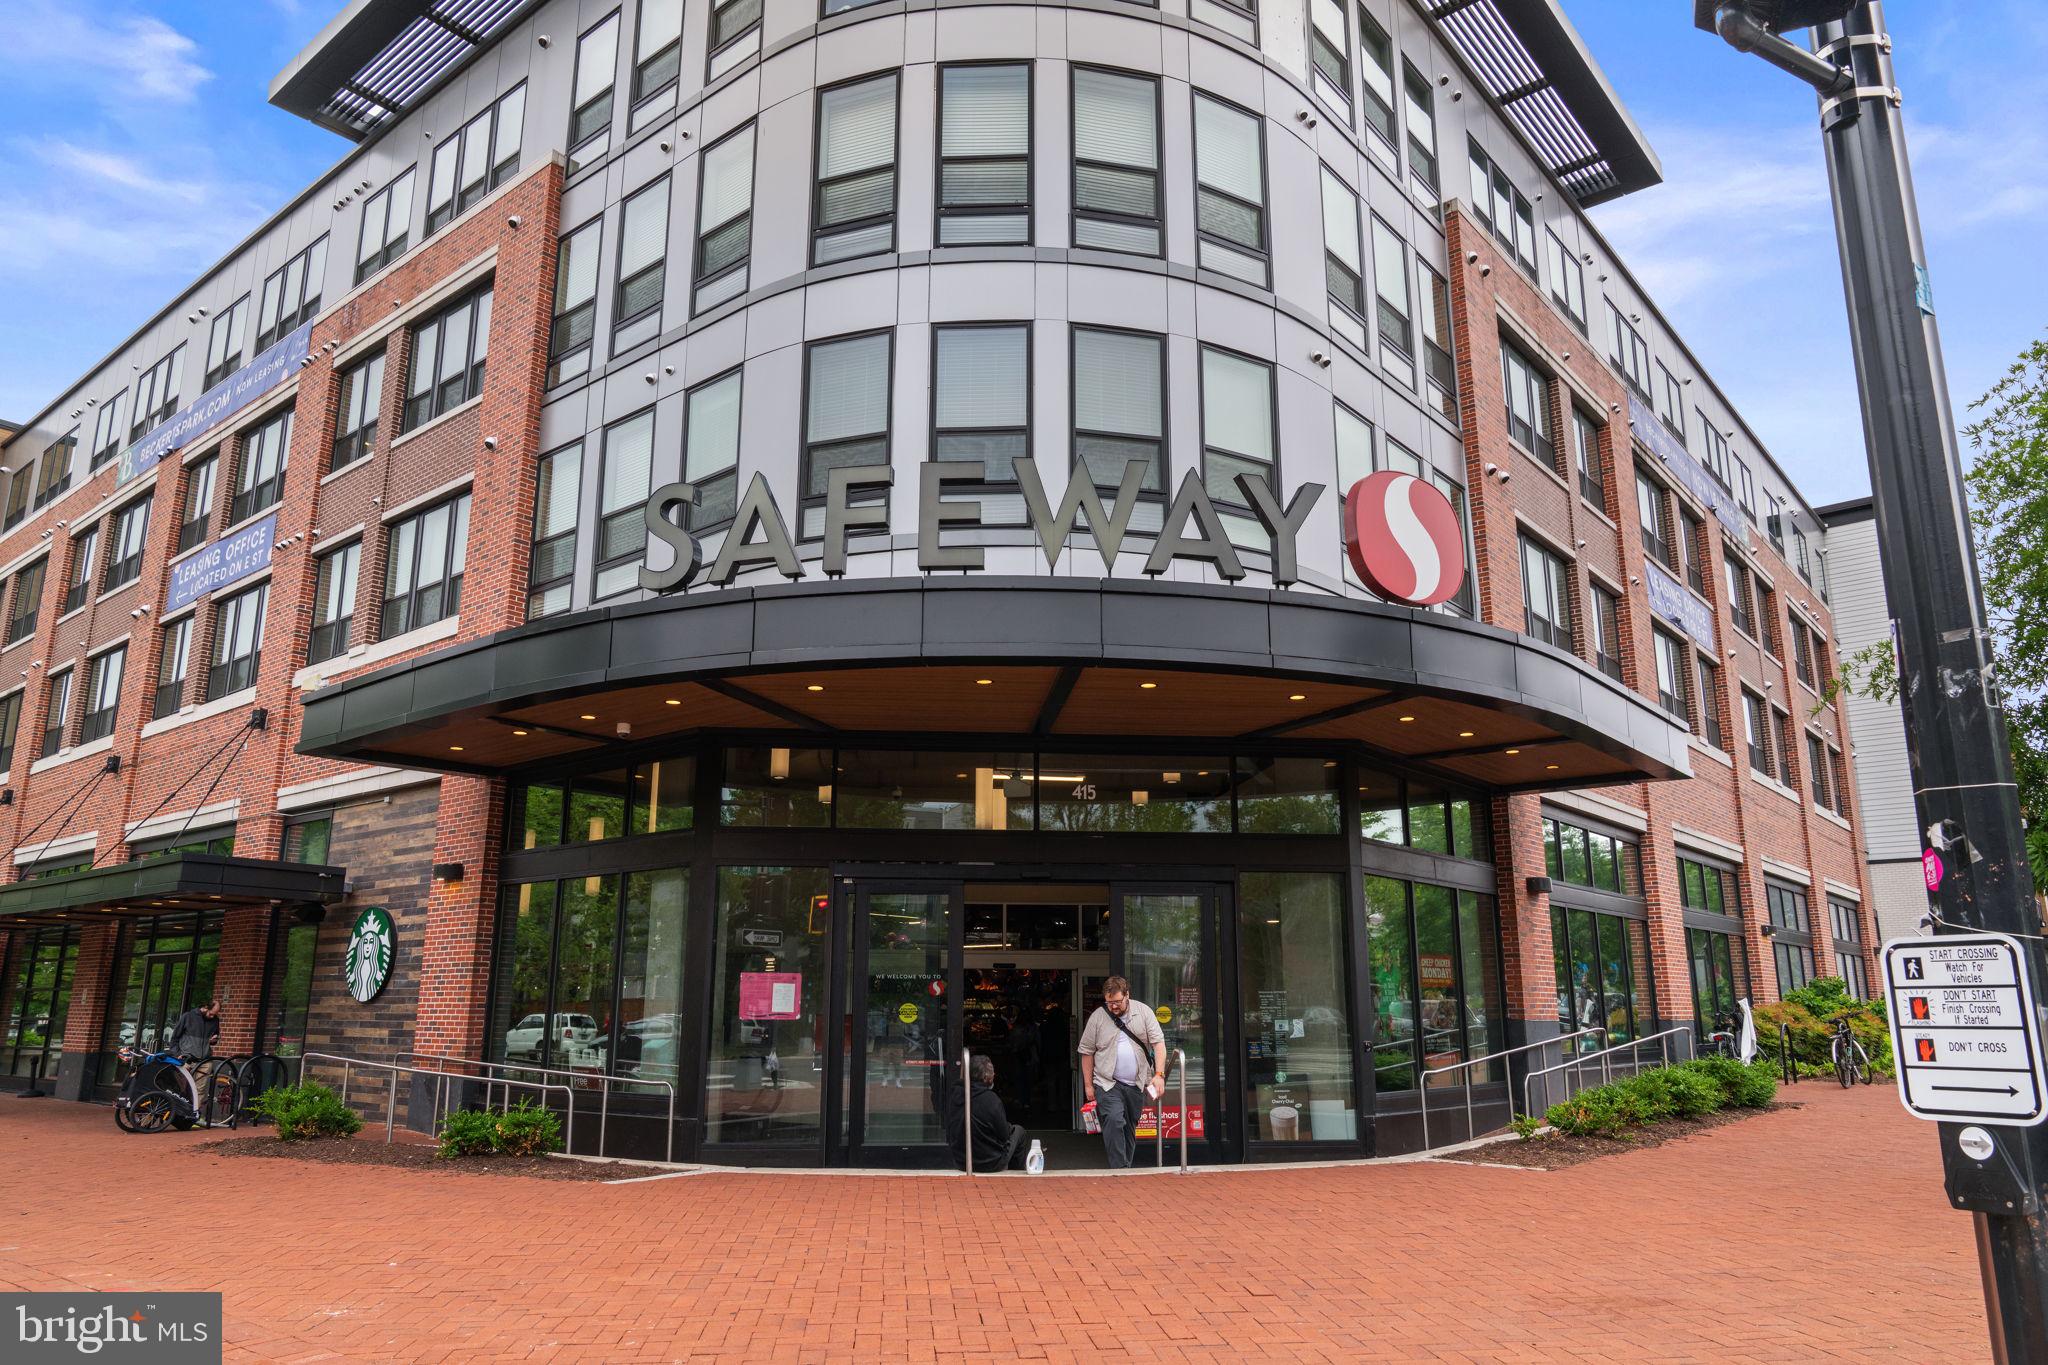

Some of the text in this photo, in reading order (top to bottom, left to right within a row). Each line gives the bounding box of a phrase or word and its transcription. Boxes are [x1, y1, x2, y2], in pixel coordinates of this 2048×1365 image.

[235, 379, 253, 396] NOW
[254, 355, 285, 384] LEASING
[638, 454, 1326, 593] SAFEWAY
[178, 526, 266, 585] LEASING OFFICE
[190, 549, 264, 595] LOCATED ON E ST
[1649, 568, 1682, 606] LEASING
[1072, 784, 1096, 800] 415
[1929, 948, 1998, 960] START CROSSING
[1945, 962, 1984, 972] Watch For
[1951, 974, 1982, 983] Vehicles
[1943, 990, 1996, 1000] DON'T START
[1942, 1004, 2001, 1016] Finish Crossing
[1954, 1015, 1989, 1025] If Started
[1948, 1042, 2007, 1053] DON'T CROSS
